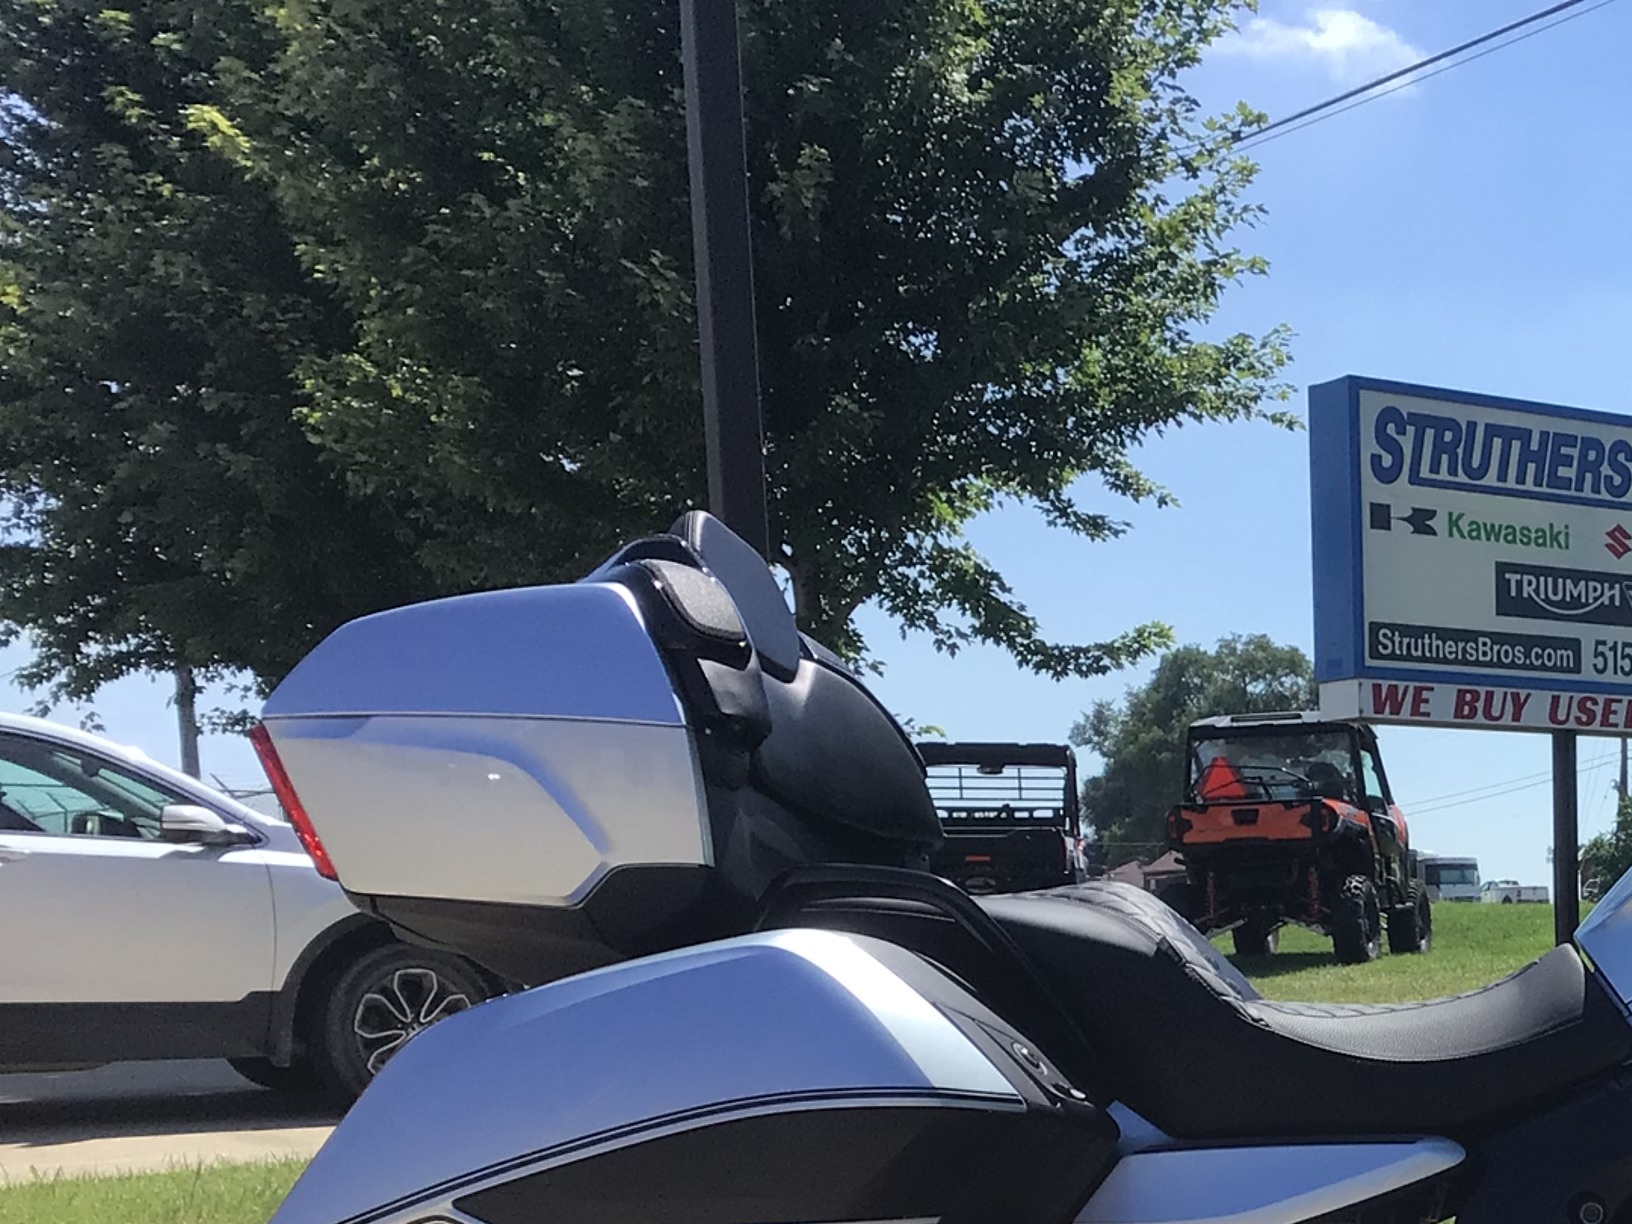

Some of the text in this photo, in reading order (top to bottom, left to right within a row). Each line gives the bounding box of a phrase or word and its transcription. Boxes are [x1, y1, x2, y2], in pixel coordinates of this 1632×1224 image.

[1447, 511, 1571, 551] Kawasaki
[1504, 572, 1621, 614] TRIUMPH
[1377, 627, 1575, 669] StruthersBros.com
[1371, 682, 1435, 718] WE
[1453, 687, 1532, 723] BUY
